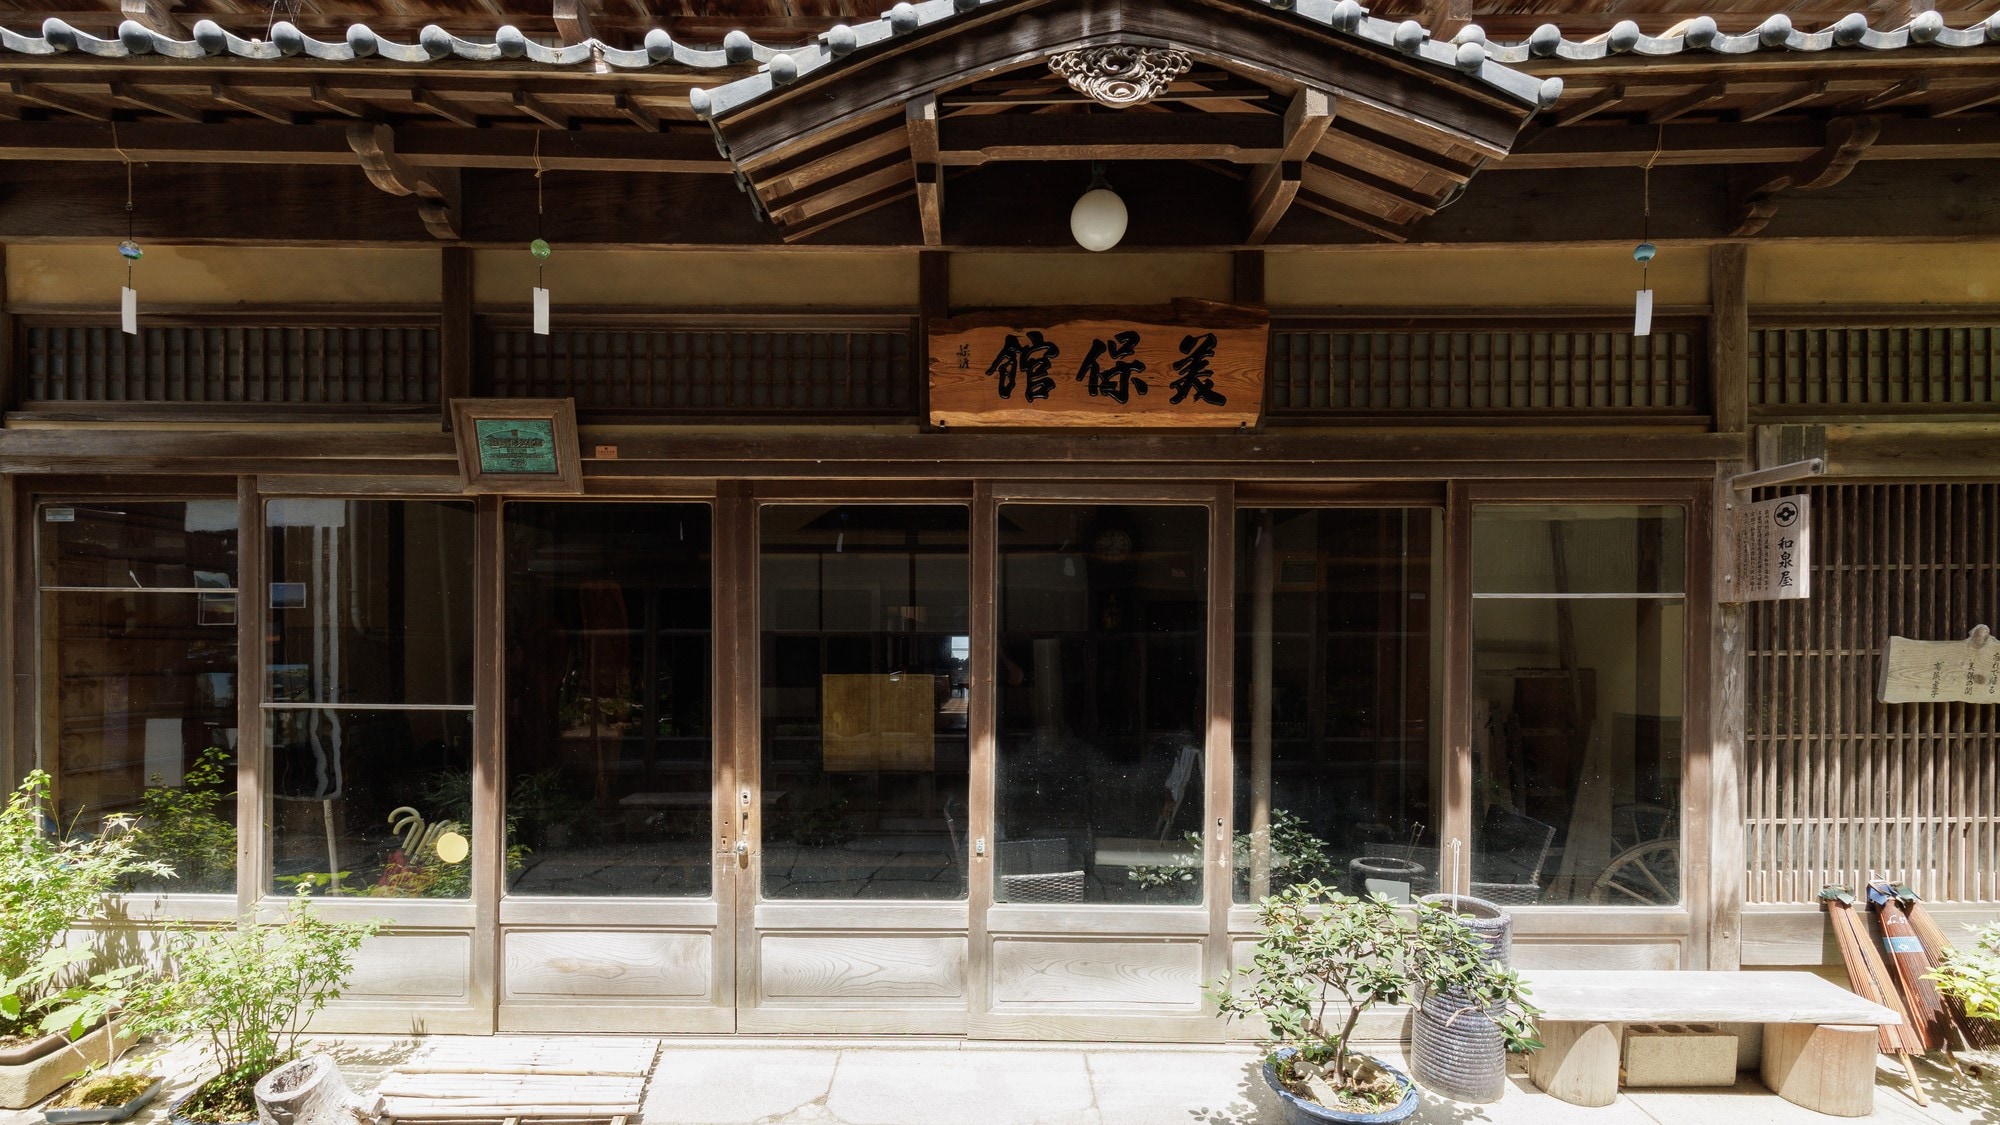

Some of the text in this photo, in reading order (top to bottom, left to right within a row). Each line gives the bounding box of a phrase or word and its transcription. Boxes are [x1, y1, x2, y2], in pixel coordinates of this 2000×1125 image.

[985, 330, 1227, 406] 美保館
[1777, 536, 1794, 588] 和泉屋
